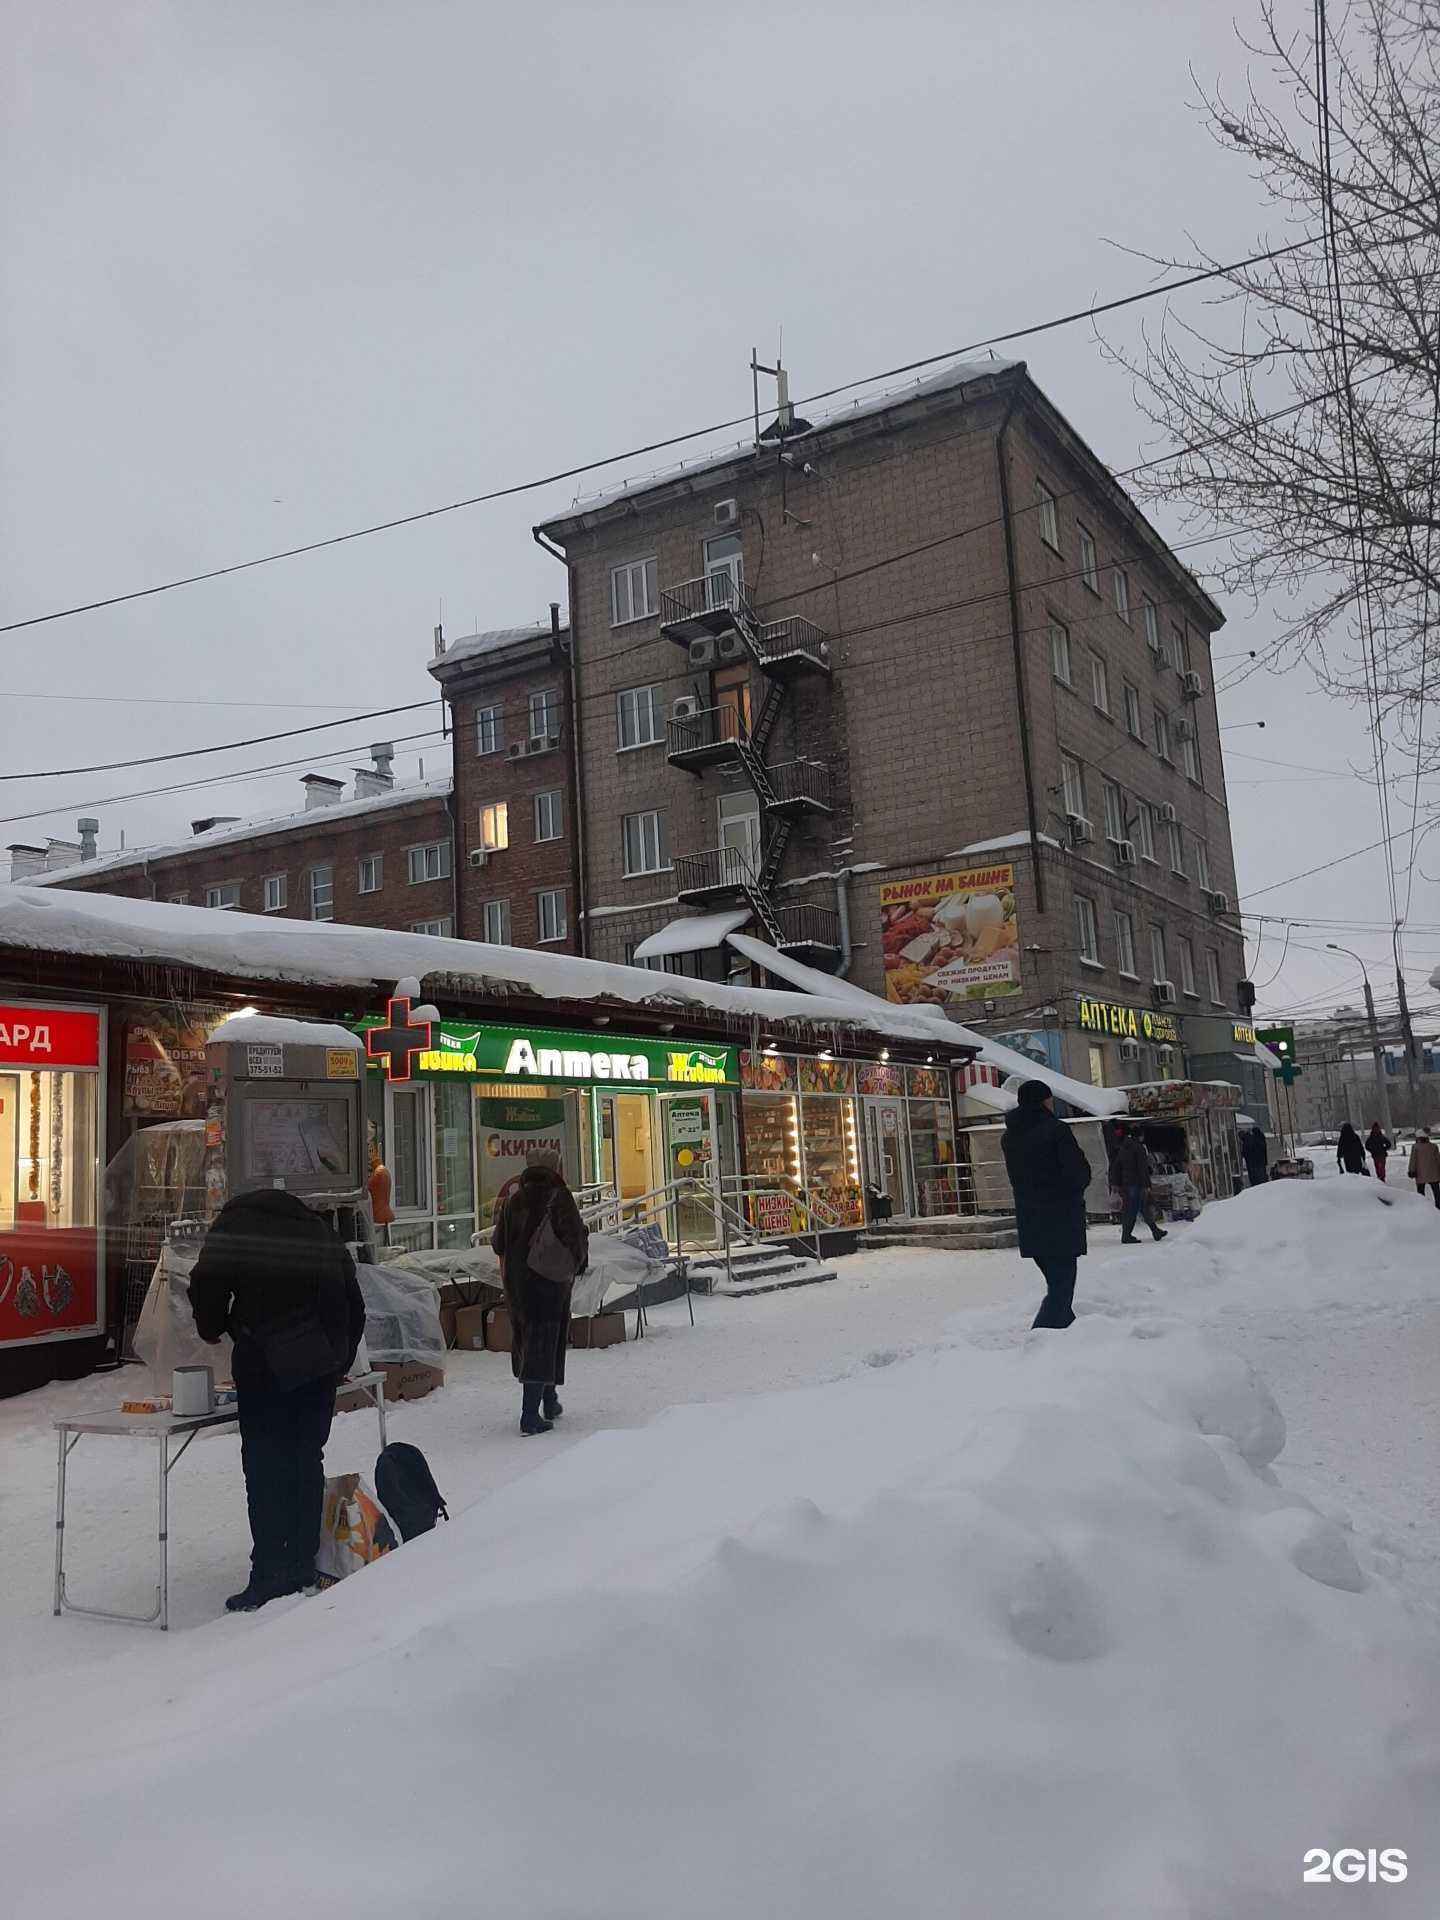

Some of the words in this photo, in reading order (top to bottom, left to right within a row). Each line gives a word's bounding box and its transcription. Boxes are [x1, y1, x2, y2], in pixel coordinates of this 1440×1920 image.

[883, 880, 932, 900] РЫНОК
[935, 877, 954, 893] НА
[958, 868, 1010, 889] БАШНЕ
[967, 963, 1008, 974] ПРОДУКТЫ
[951, 976, 980, 985] НИЗКИМ
[983, 973, 1009, 981] ЦЕНАМ
[1081, 999, 1138, 1038] АПТЕКА
[504, 1039, 649, 1081] Аптека
[759, 1195, 794, 1212] НИЗКИЕ
[764, 1215, 791, 1231] ЦЕНЫ
